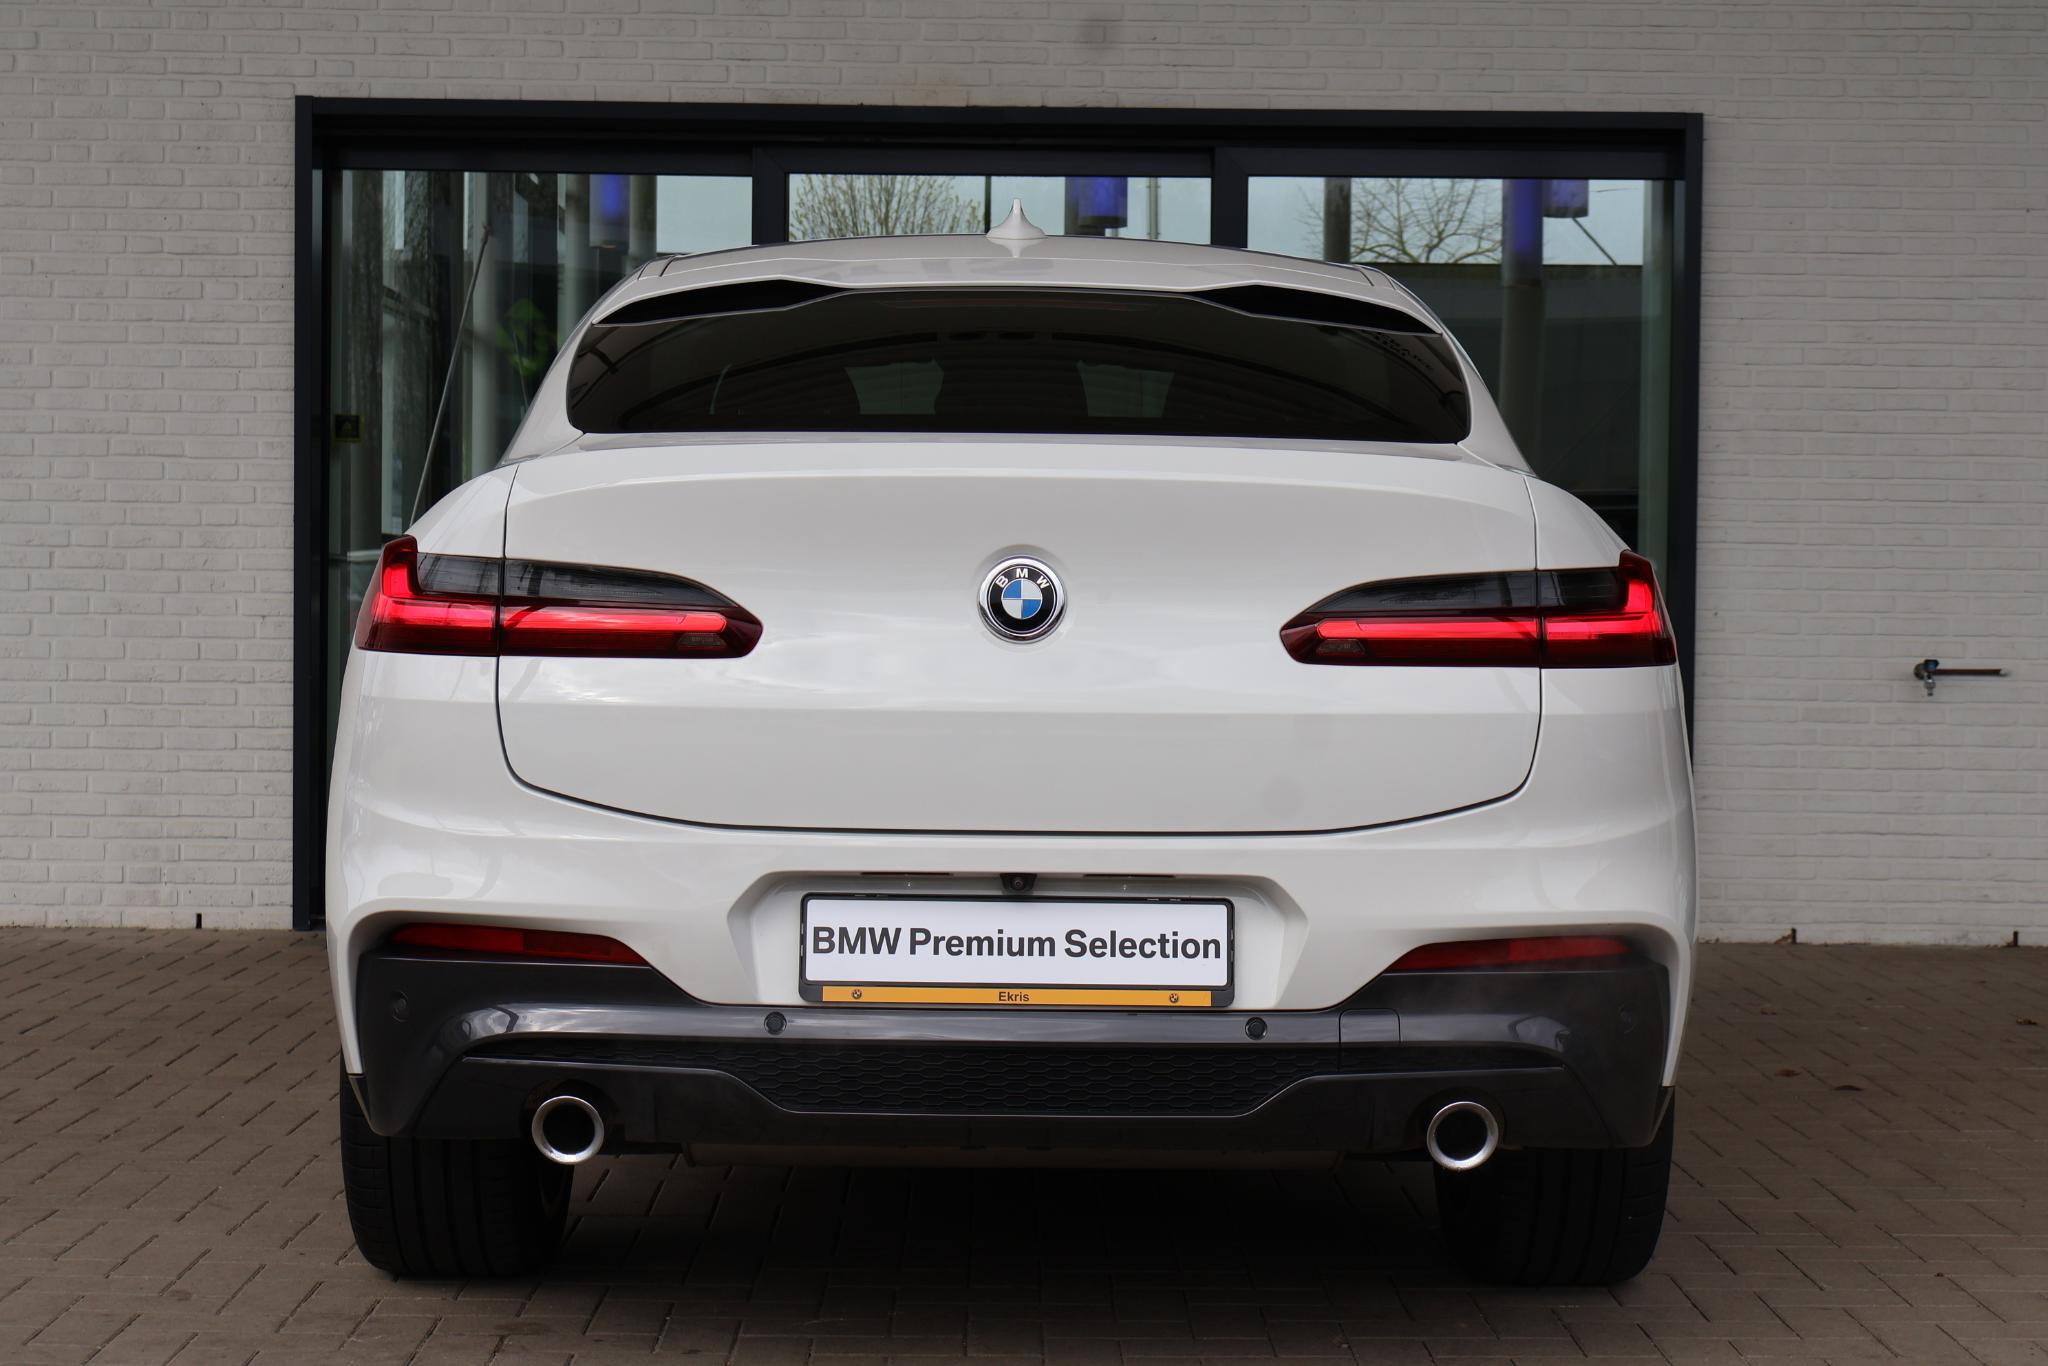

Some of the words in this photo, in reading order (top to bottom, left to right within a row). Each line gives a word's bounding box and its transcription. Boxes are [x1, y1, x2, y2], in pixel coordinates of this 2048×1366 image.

[995, 567, 1050, 589] BMW
[812, 926, 902, 955] BMW
[909, 927, 1056, 957] Premium
[1064, 929, 1221, 960] Selection
[998, 990, 1030, 1003] Ekris
